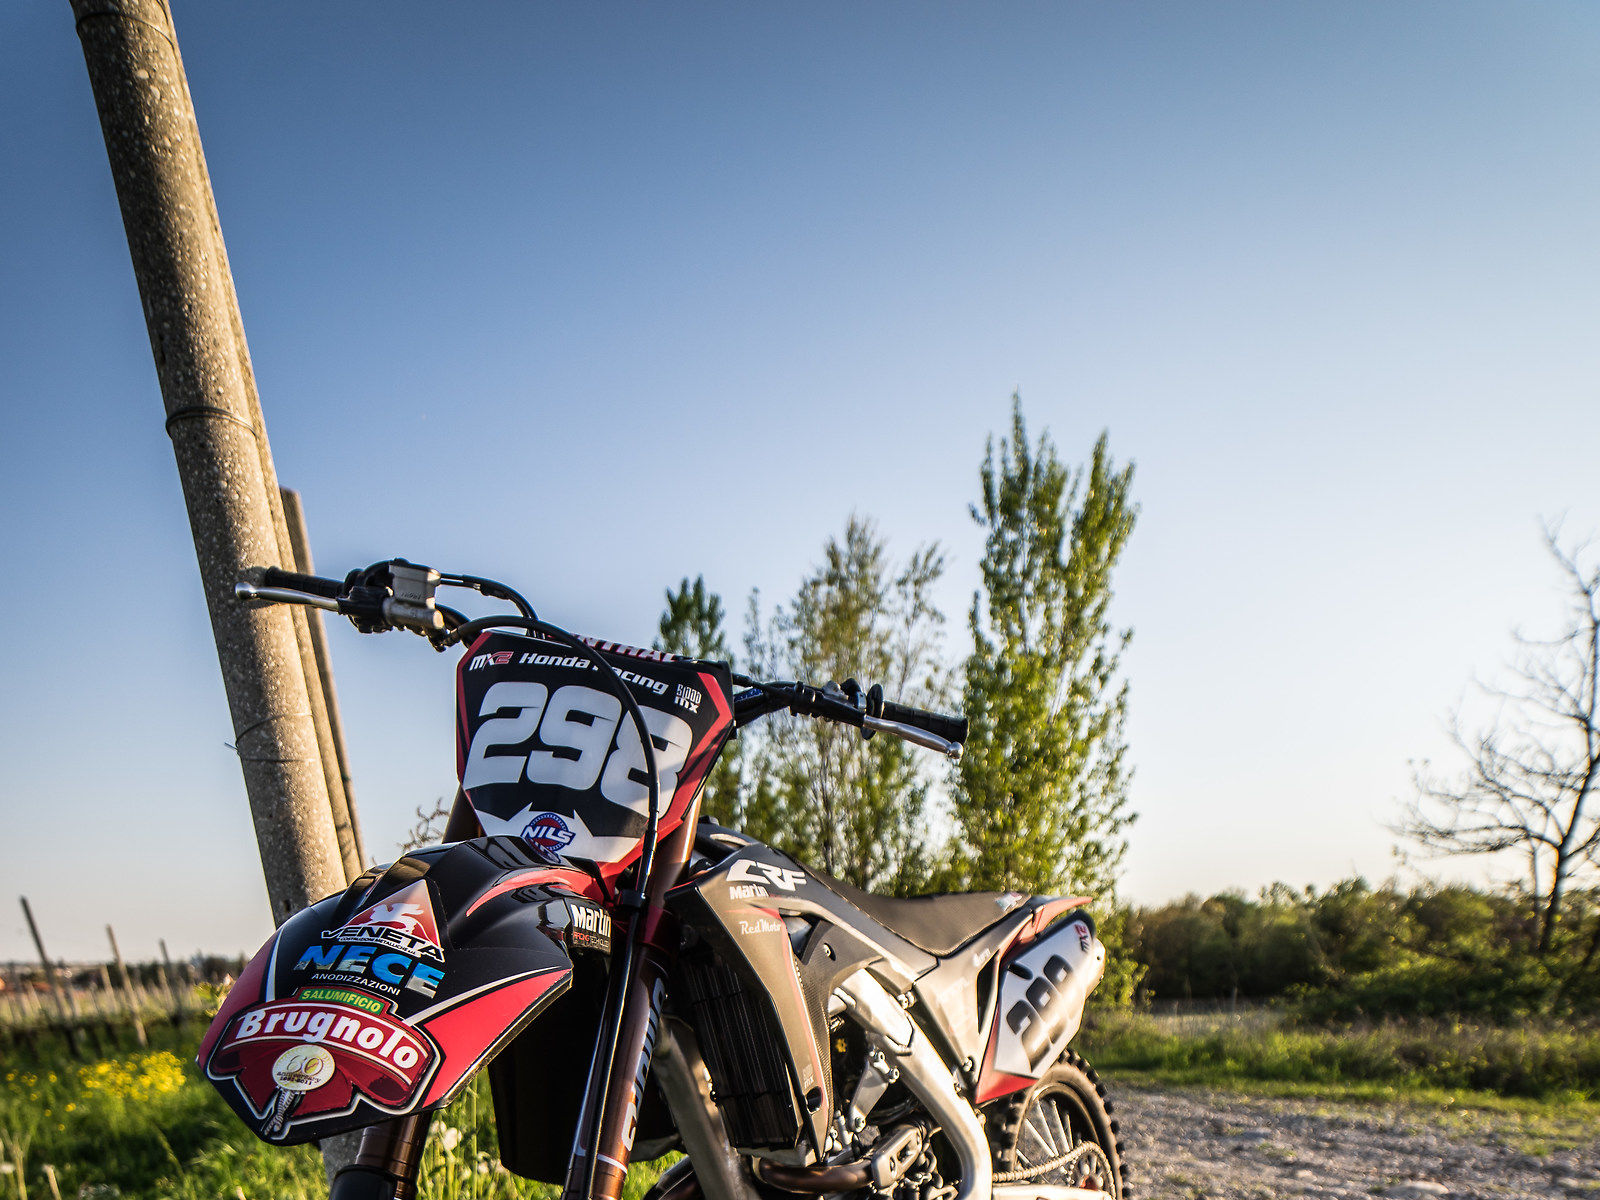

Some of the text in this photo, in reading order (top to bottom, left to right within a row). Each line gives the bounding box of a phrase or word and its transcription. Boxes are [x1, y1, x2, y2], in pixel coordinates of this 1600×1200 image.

[519, 652, 590, 669] Honda
[593, 664, 669, 695] acing
[464, 681, 693, 820] 298
[521, 825, 575, 844] NILS
[726, 859, 808, 892] CRF
[729, 884, 770, 900] Martin
[570, 904, 612, 938] Martin
[321, 926, 445, 962] VENETA
[294, 944, 446, 999] NECE
[311, 972, 401, 996] ANODIZZAZIONI
[301, 989, 382, 1013] SALUMIFICIO
[235, 1010, 419, 1069] Brugnolo
